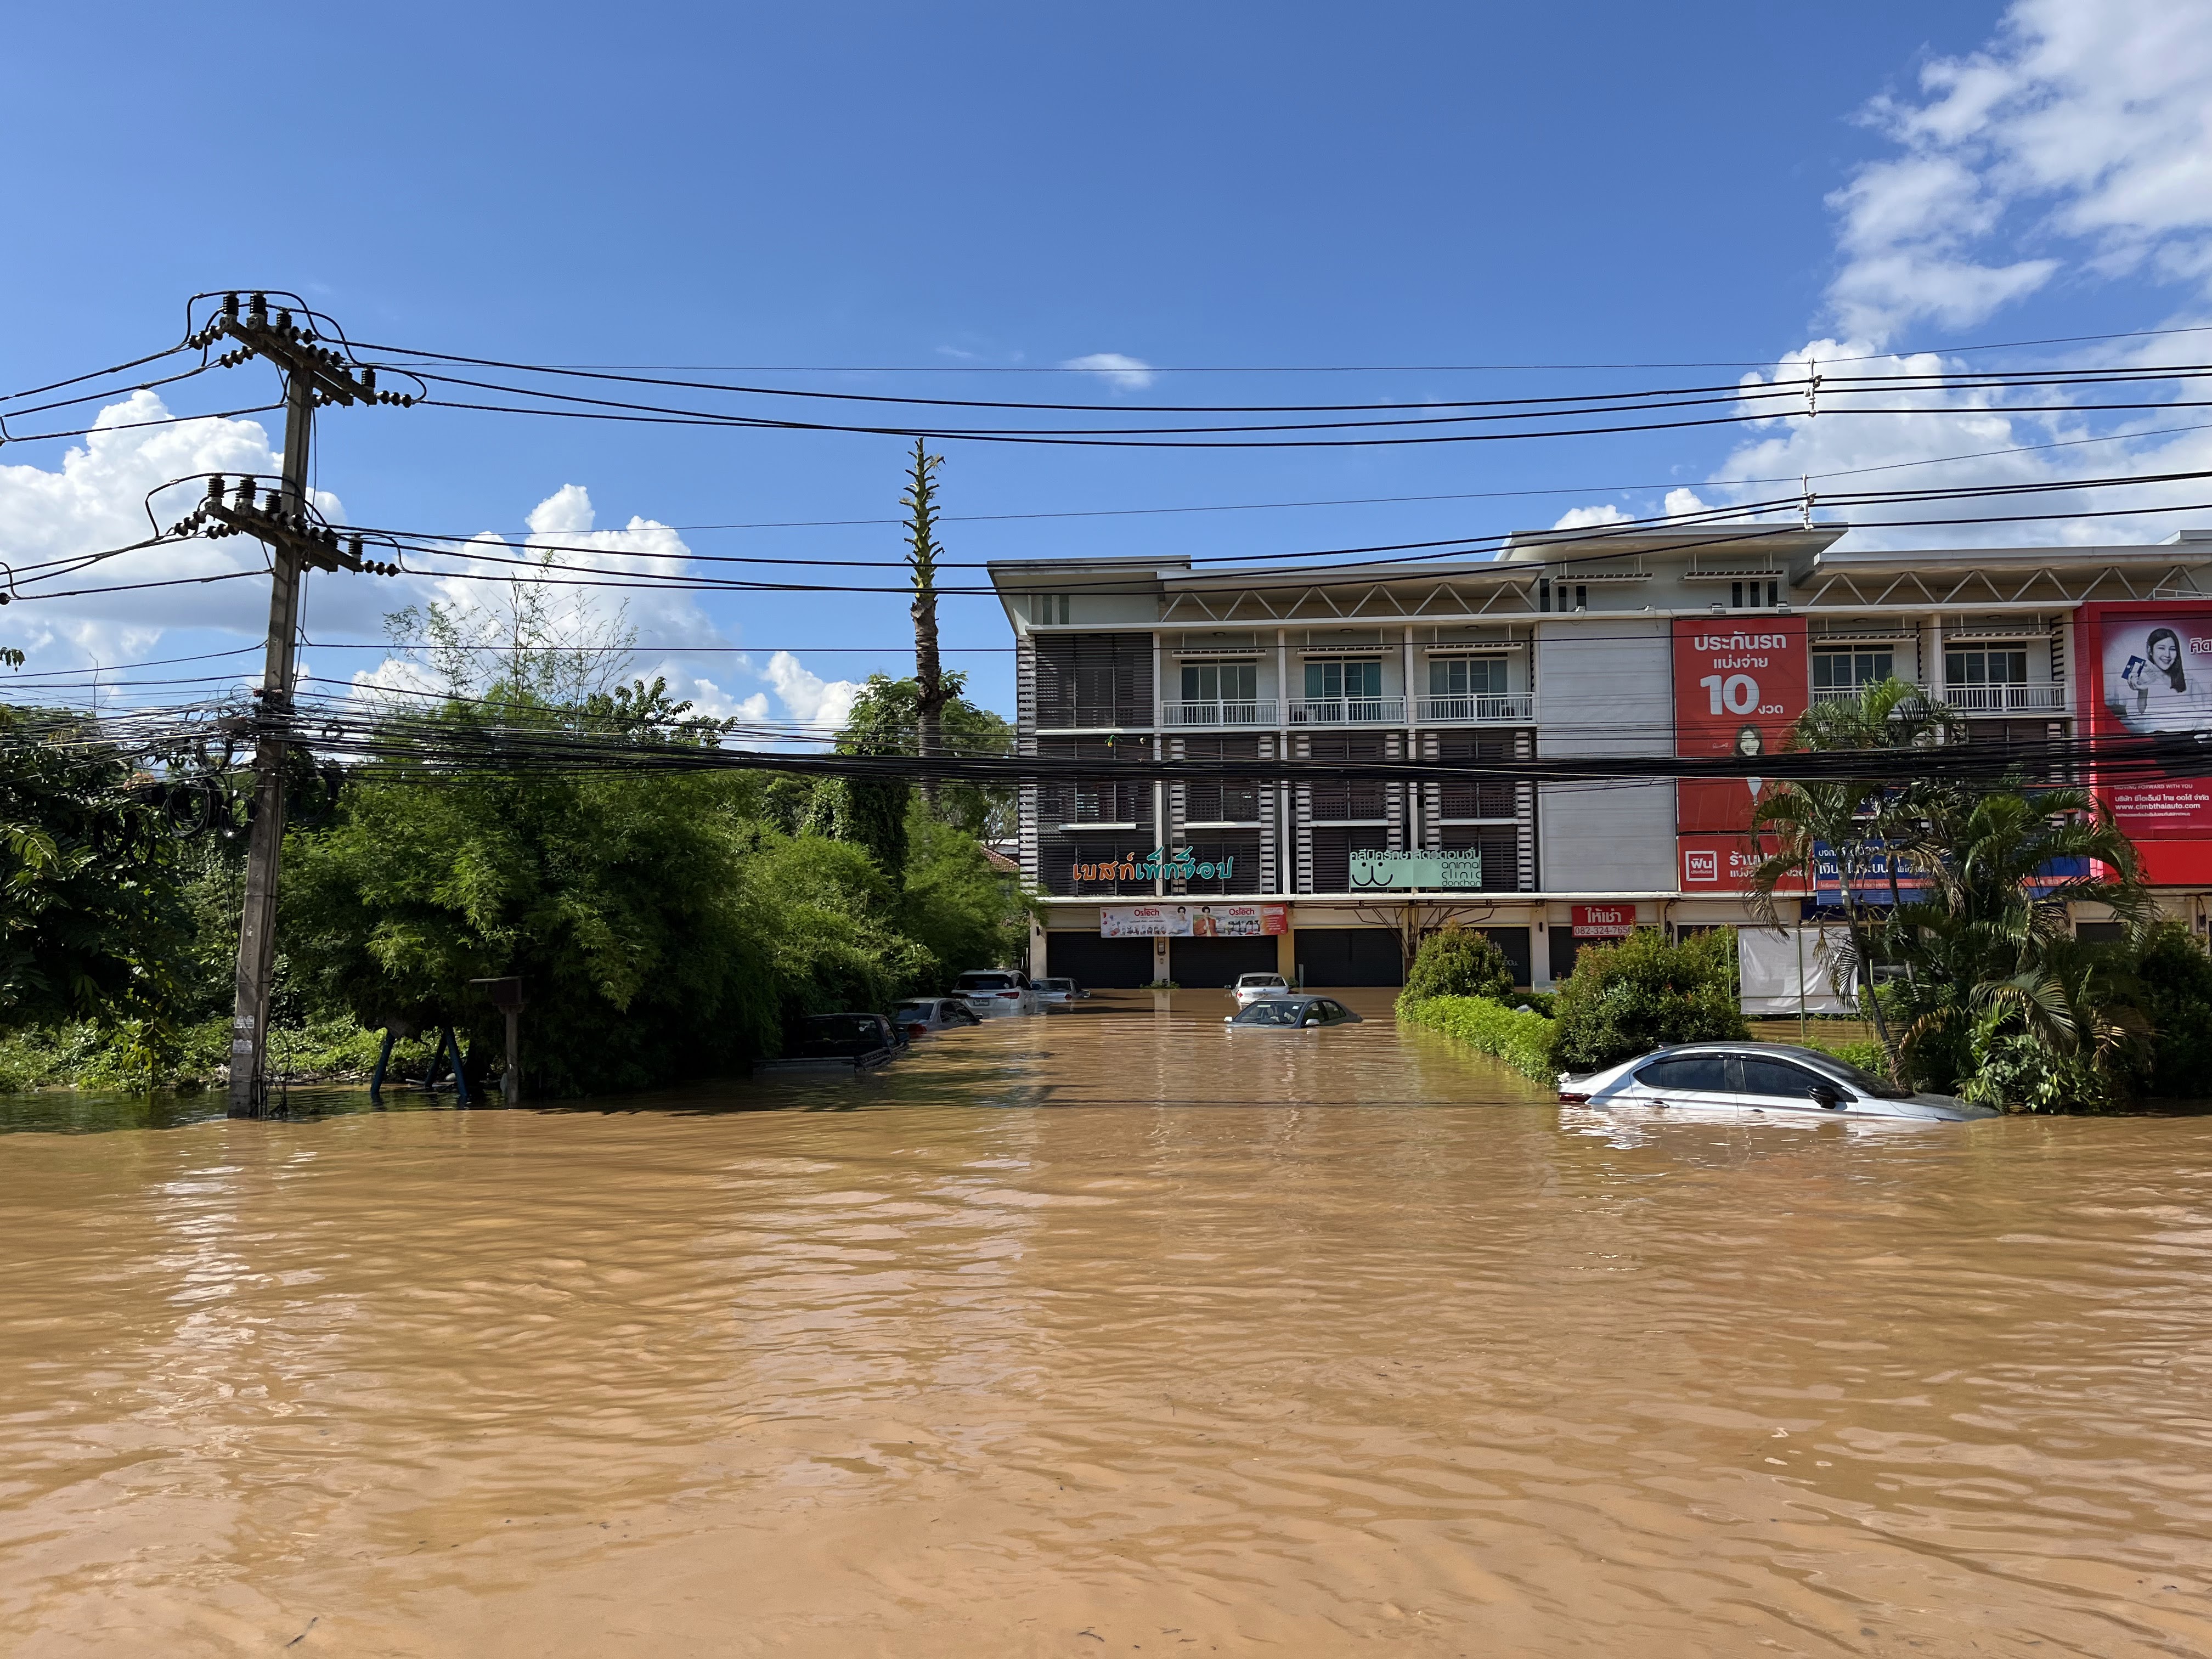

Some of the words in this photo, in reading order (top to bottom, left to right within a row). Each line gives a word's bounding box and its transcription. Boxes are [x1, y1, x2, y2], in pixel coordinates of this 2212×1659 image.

[1694, 631, 1786, 651] ประกันรถ
[1713, 654, 1768, 669] แบ่งจ่าย
[1700, 674, 1759, 715] 10
[1758, 704, 1784, 714] งวด
[1441, 859, 1481, 869] animal
[1441, 868, 1481, 879] clinic
[1584, 906, 1622, 923] ให้เช่า
